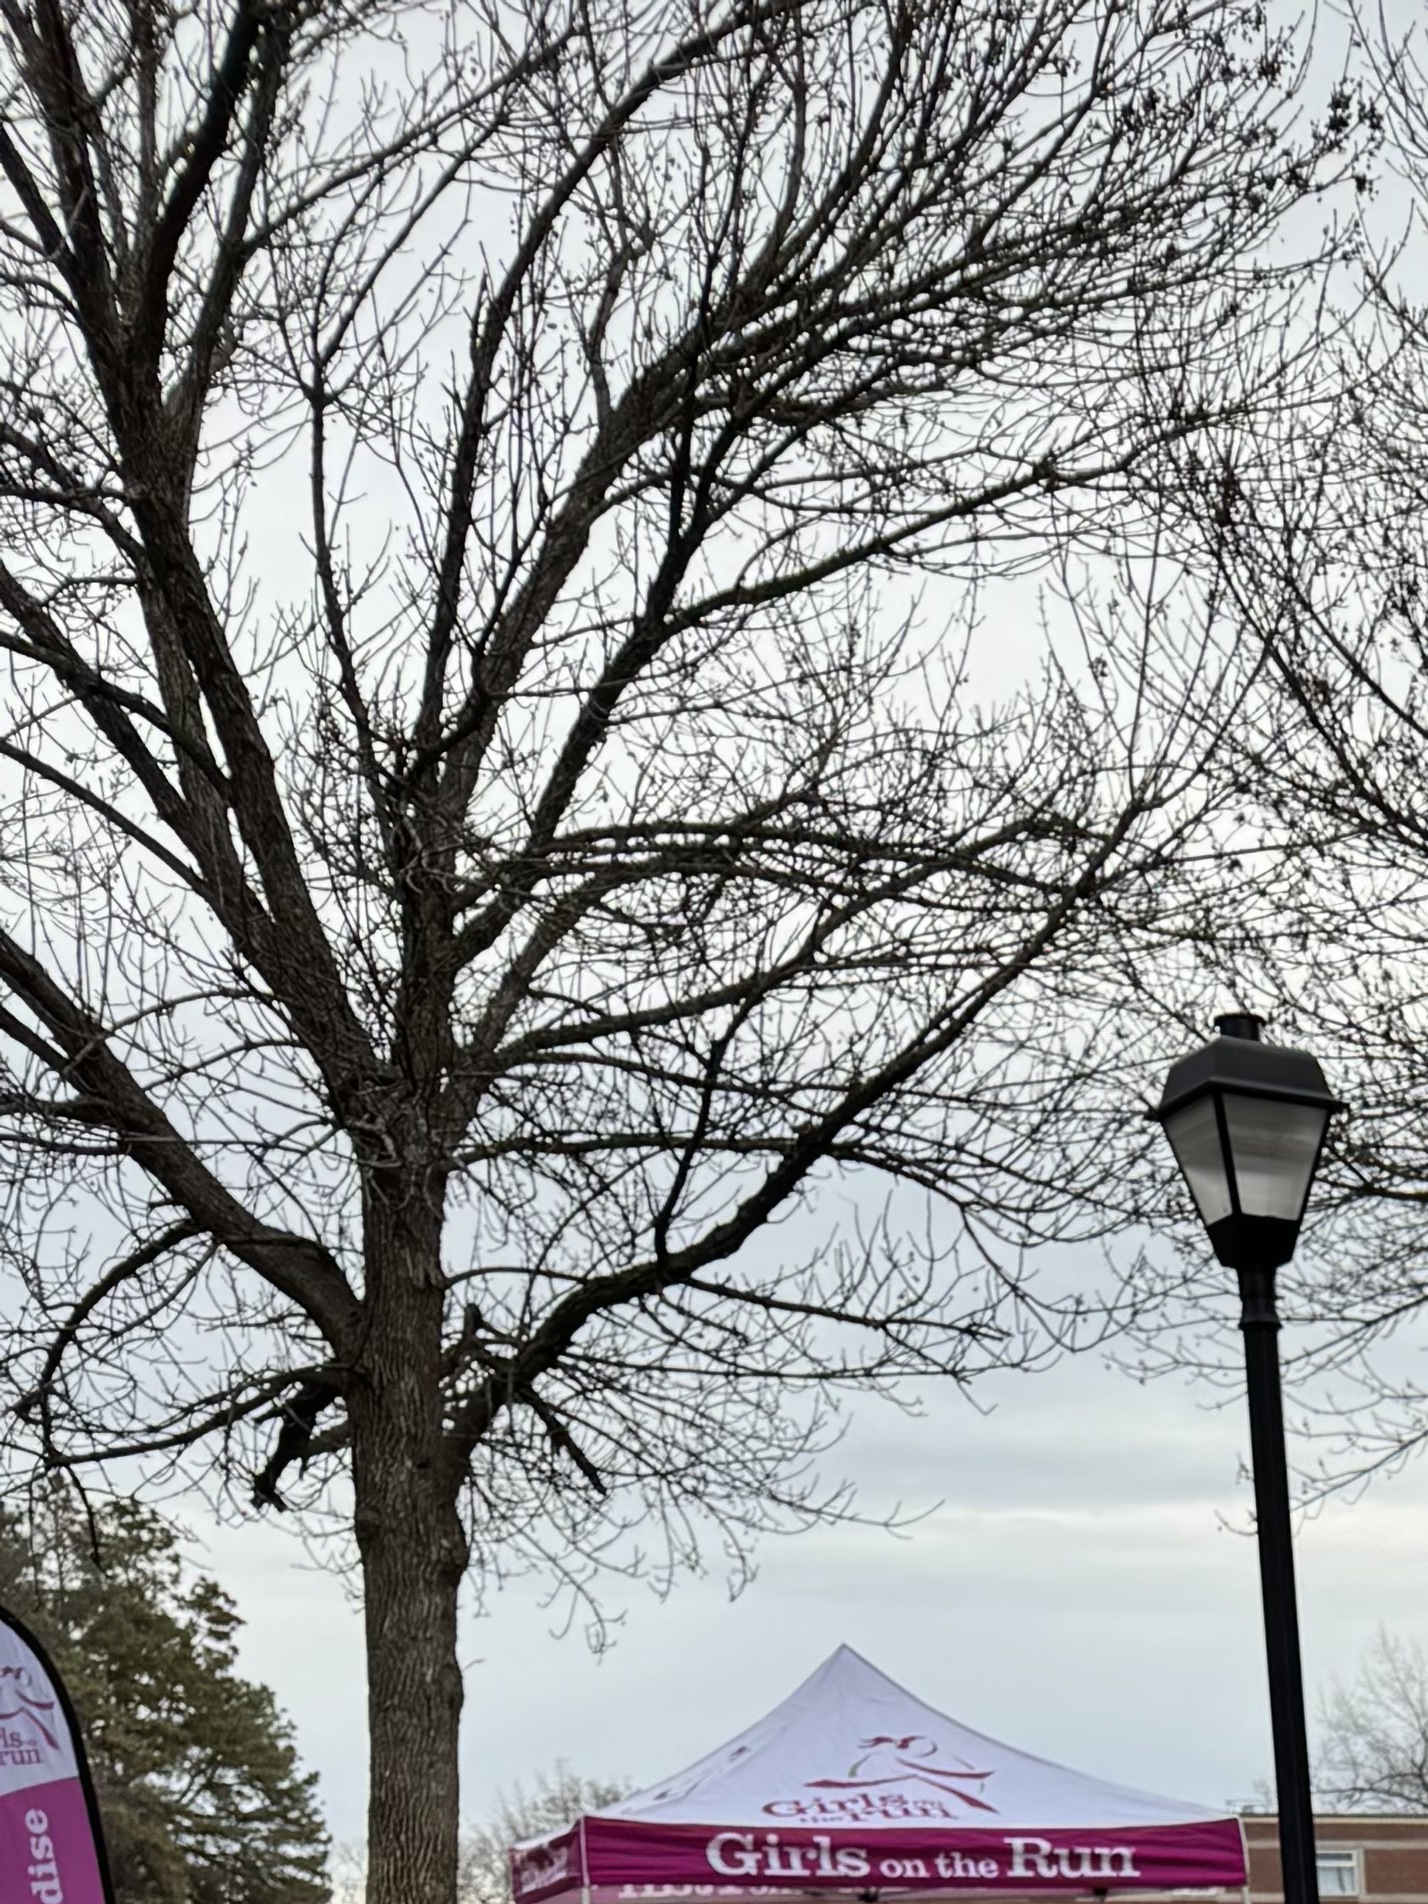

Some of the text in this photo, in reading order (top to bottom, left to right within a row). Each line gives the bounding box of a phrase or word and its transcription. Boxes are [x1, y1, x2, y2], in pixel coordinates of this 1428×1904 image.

[705, 1832, 1141, 1878] Girls on the Run
